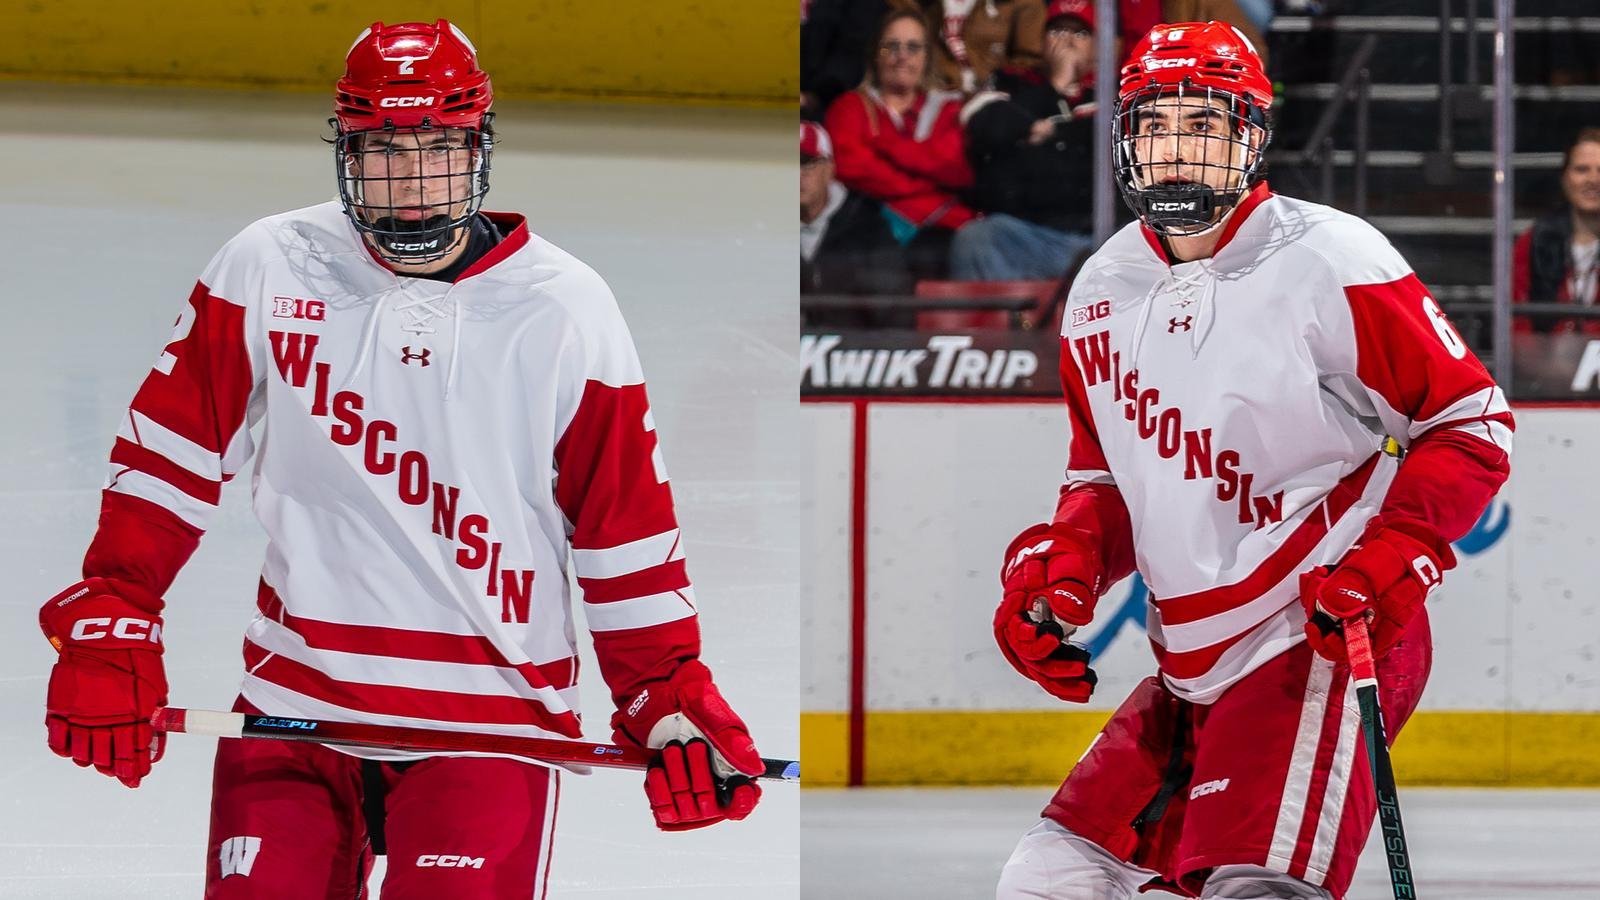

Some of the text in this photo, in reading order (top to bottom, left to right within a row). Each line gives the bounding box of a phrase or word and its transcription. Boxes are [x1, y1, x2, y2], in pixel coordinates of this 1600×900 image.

[399, 56, 414, 75] 2
[381, 96, 434, 107] CCM
[1152, 202, 1196, 211] CCM
[390, 239, 438, 251] CCM
[1422, 296, 1466, 360] 6
[1074, 330, 1284, 531] WISCONSIN
[268, 330, 535, 624] WISCONSIN
[57, 587, 90, 607] WISCONSIN
[628, 689, 649, 716] CCM
[1190, 778, 1230, 800] CCM
[1378, 790, 1414, 900] JETSPEE
[416, 854, 485, 869] CCM
